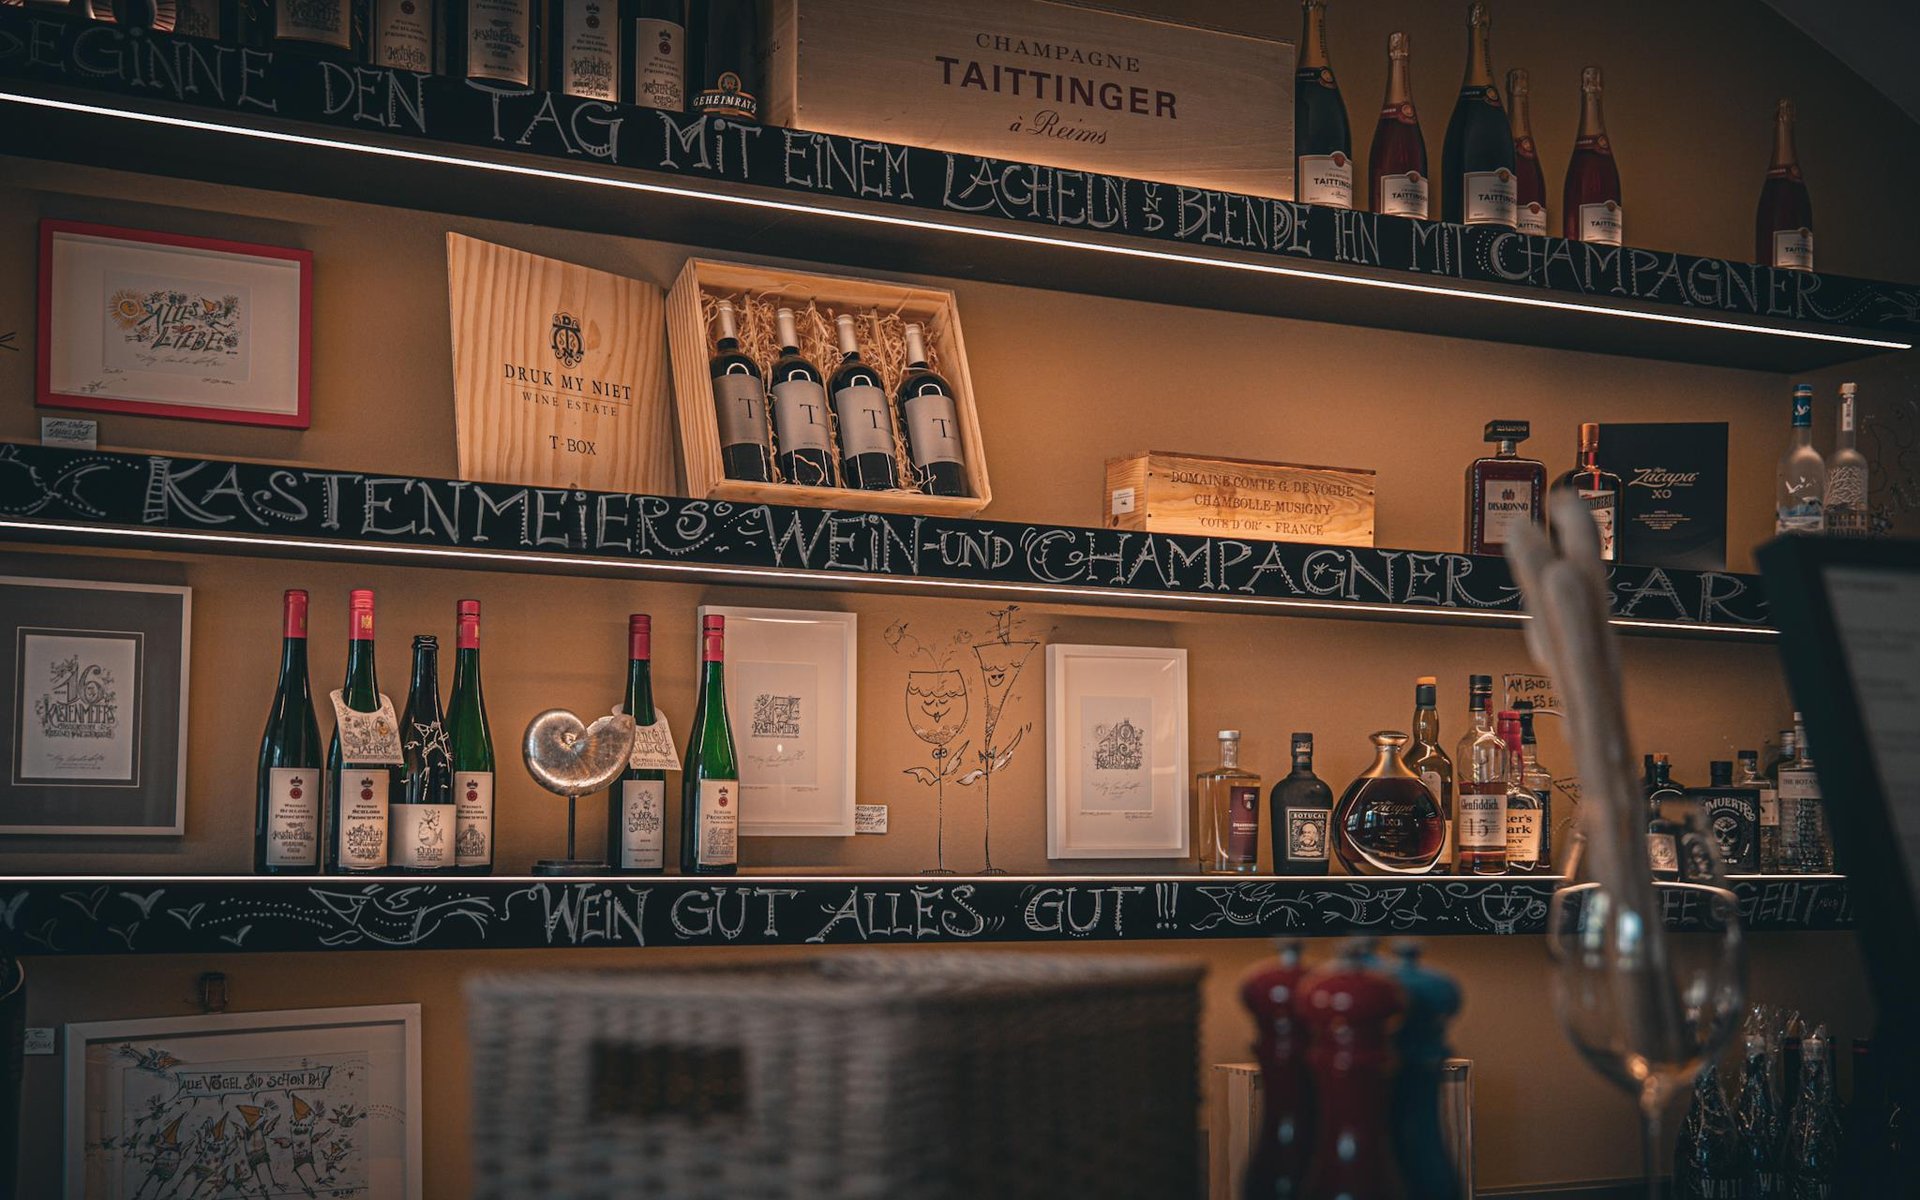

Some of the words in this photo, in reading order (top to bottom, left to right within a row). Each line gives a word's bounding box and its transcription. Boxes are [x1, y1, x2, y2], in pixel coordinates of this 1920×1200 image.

[975, 32, 1140, 73] CHAMPAGNE
[934, 56, 1178, 119] TAITTINGER
[1027, 109, 1108, 145] Reims
[317, 61, 432, 130] DEN
[465, 78, 624, 163] TAG
[1174, 185, 1312, 257] BEENDE
[1488, 230, 1832, 320] CHAMPAGNER
[504, 363, 553, 387] DRUK
[561, 374, 584, 392] MY
[592, 380, 632, 400] NIET
[522, 391, 559, 407] WINE
[567, 399, 618, 417] ESTATE
[739, 398, 757, 419] T
[799, 404, 819, 424] T
[863, 409, 882, 429] T
[933, 418, 951, 438] T
[549, 435, 597, 456] T-BOX
[1170, 471, 1231, 488] DOMAINE
[1233, 477, 1275, 491] COMTE
[1293, 482, 1310, 495] DE
[1627, 468, 1700, 488] Zacapa
[1651, 489, 1673, 499] XO
[1488, 503, 1529, 512] DISARONNO
[1275, 522, 1325, 536] FRANCE
[1026, 528, 1480, 608] CHAMPAGNER
[1604, 566, 1755, 624] AR
[1508, 679, 1524, 692] AM
[1468, 818, 1489, 837] 15
[670, 886, 806, 940] GUT
[804, 885, 985, 942] ALLES
[1023, 885, 1146, 937] GUT
[181, 1078, 203, 1092] ALLE
[202, 1074, 241, 1092] VÖGEL
[266, 1073, 305, 1089] SCHON
